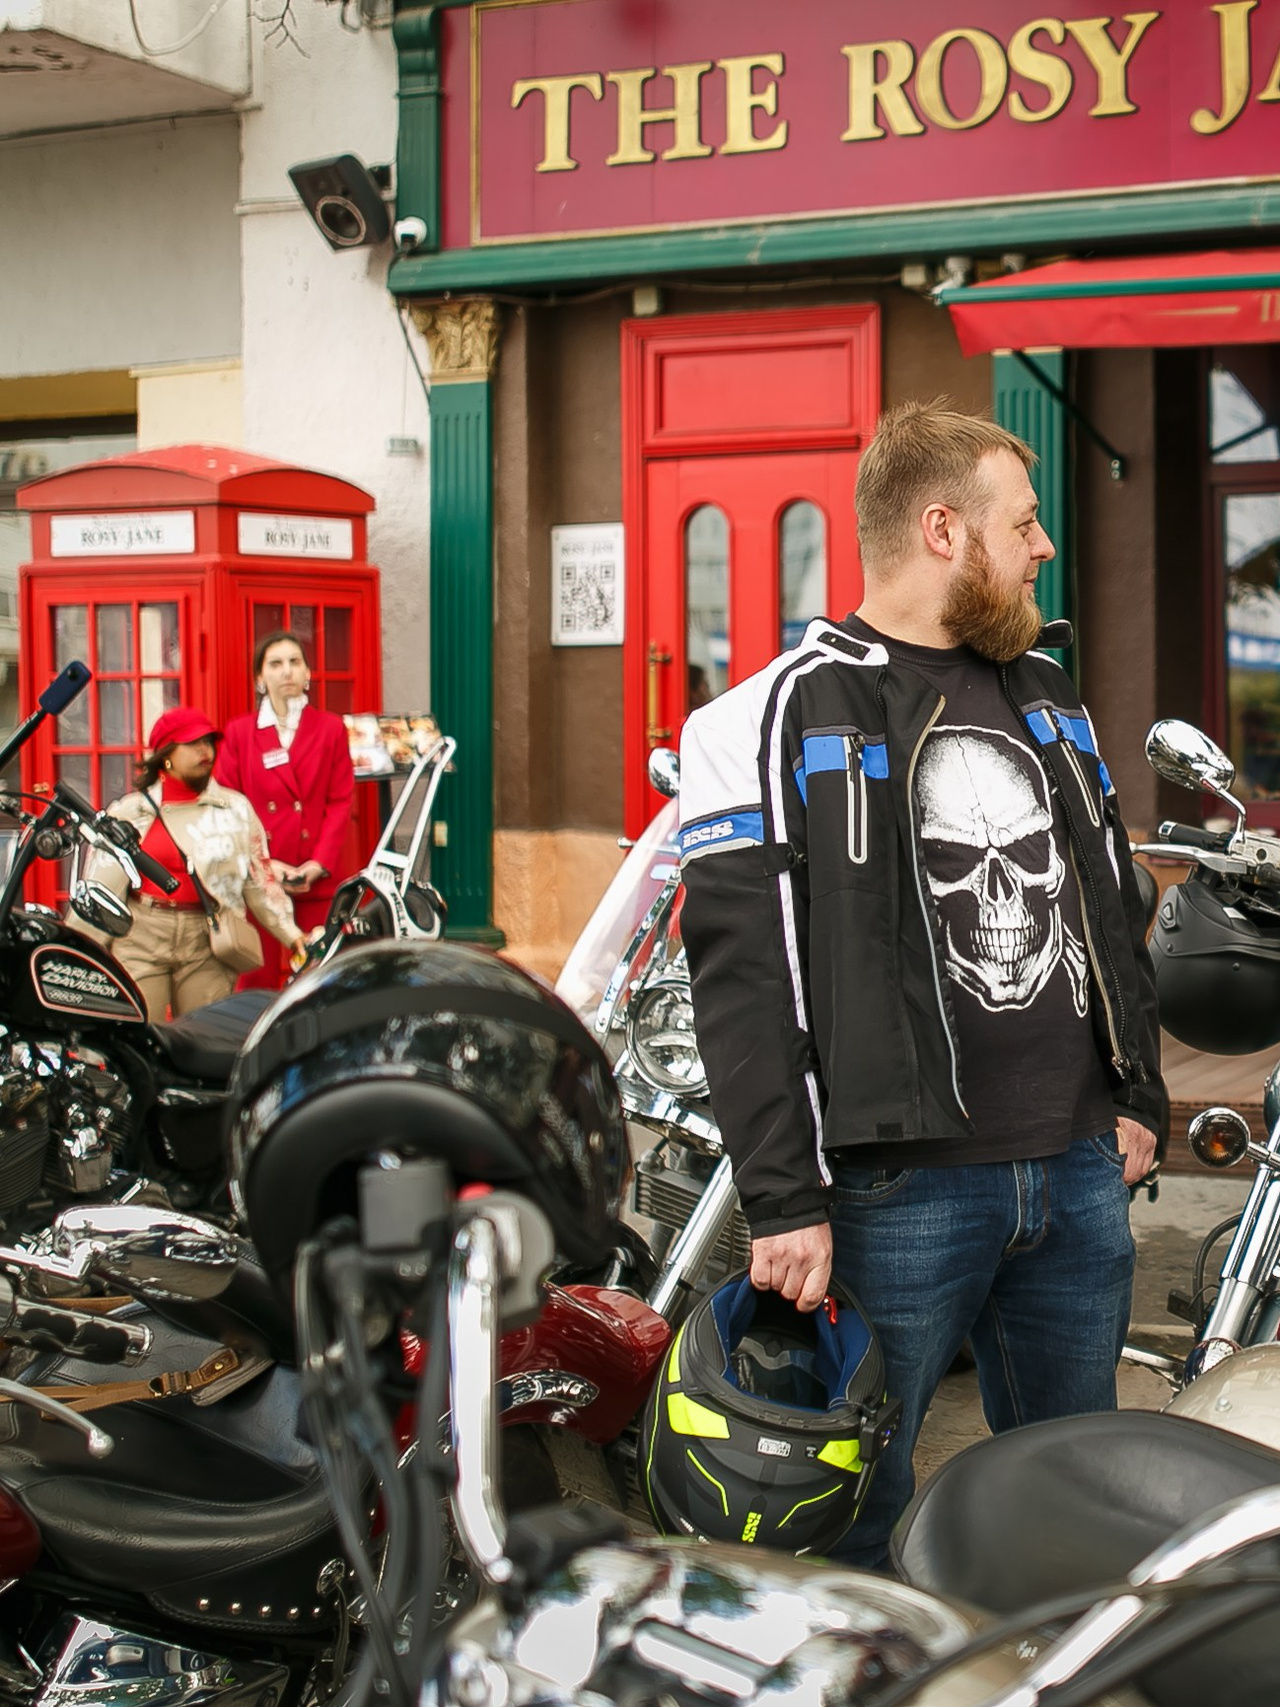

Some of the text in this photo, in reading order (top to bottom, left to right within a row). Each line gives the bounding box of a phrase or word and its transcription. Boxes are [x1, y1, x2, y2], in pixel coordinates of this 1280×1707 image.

[511, 51, 788, 172] THE
[841, 11, 1161, 142] ROSY
[41, 972, 119, 998] DAVIDSON
